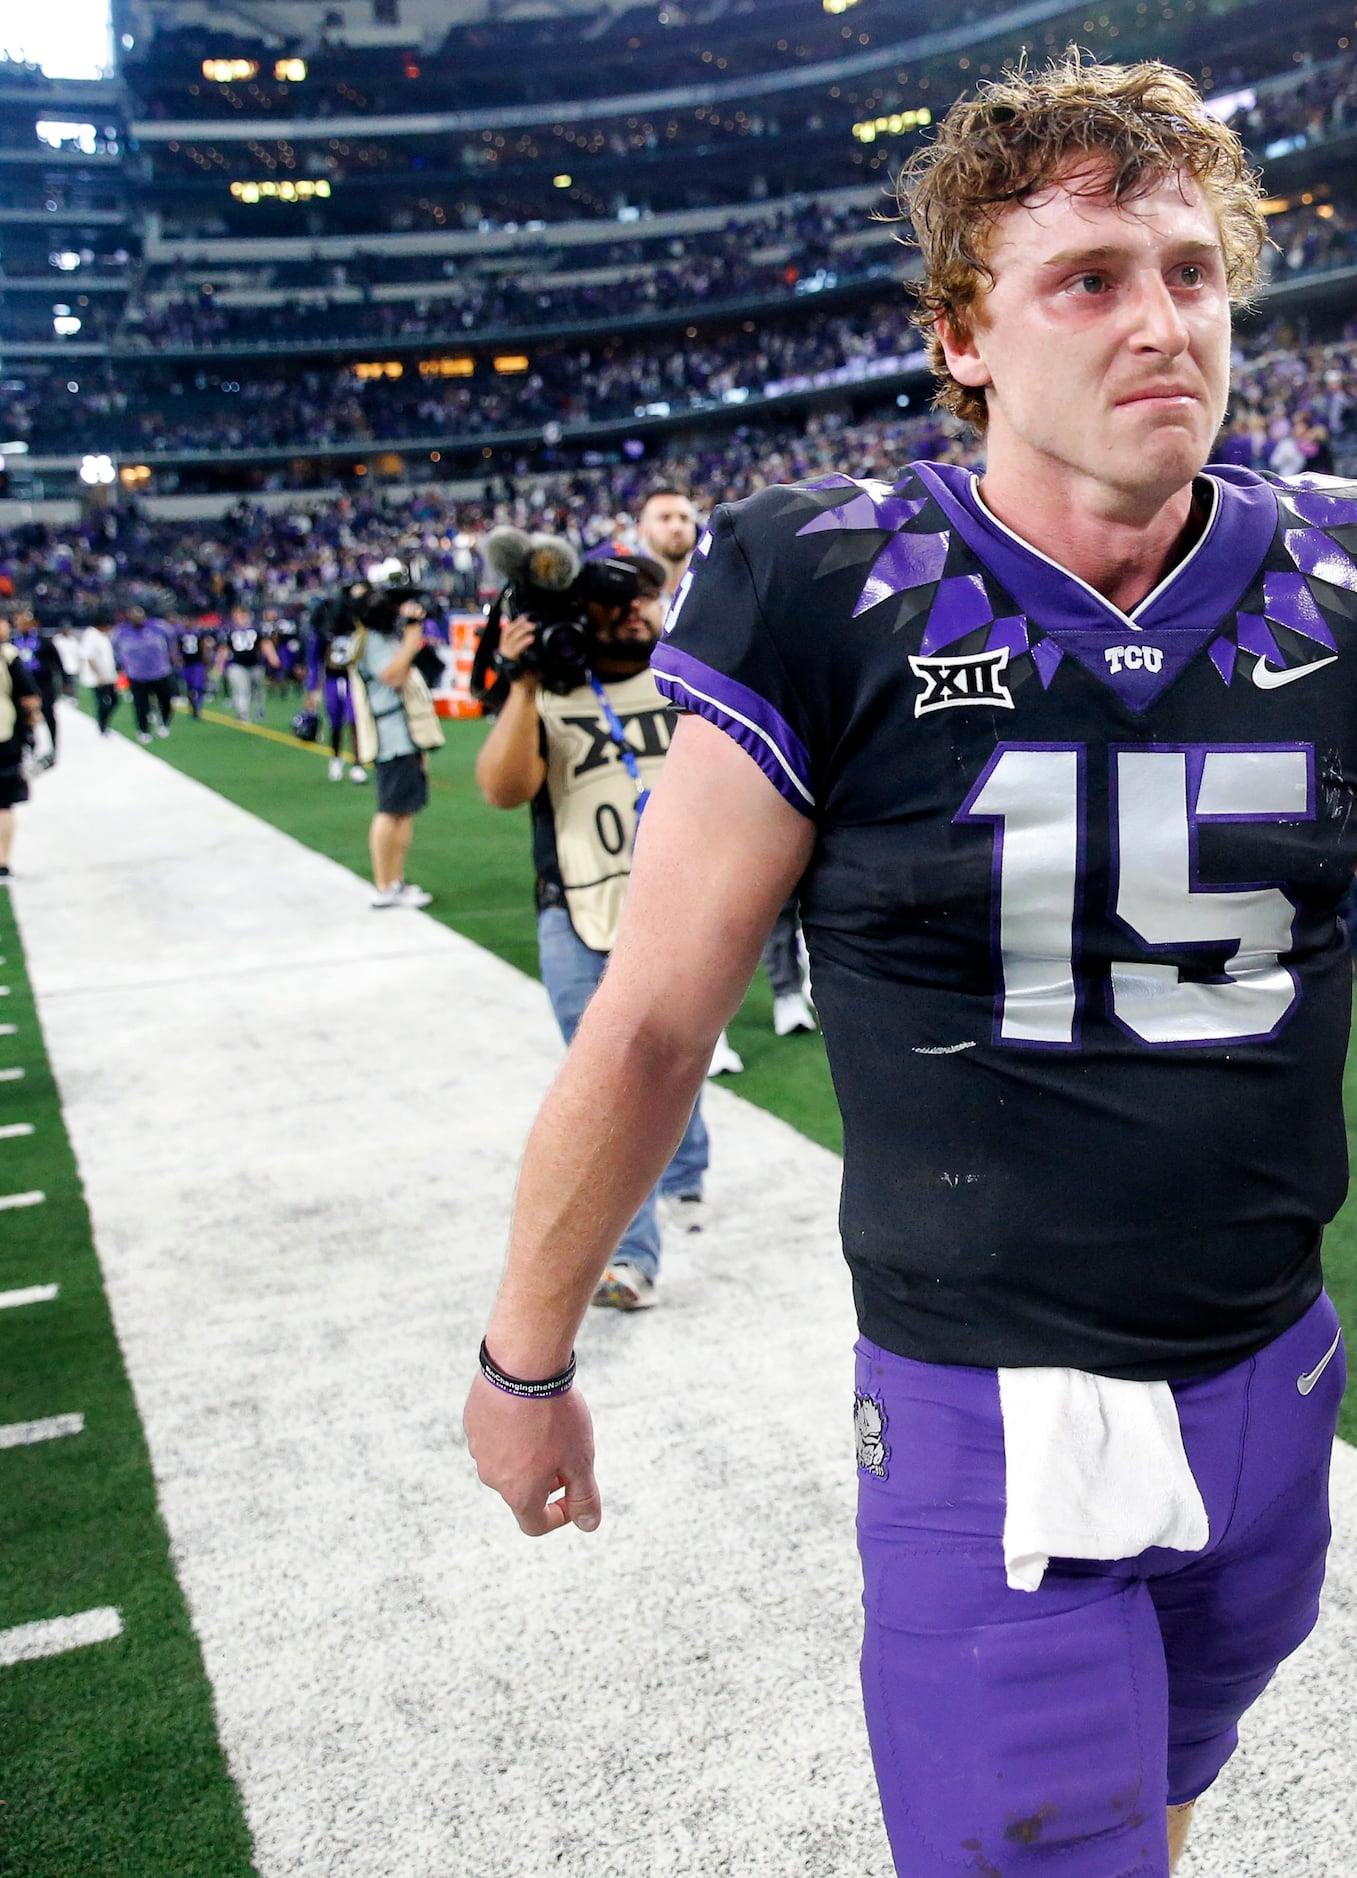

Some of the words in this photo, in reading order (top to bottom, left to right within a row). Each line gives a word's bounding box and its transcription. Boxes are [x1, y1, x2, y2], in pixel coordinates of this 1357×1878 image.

[912, 652, 1010, 713] XII
[1104, 645, 1164, 674] TCU
[951, 741, 1316, 1048] 15
